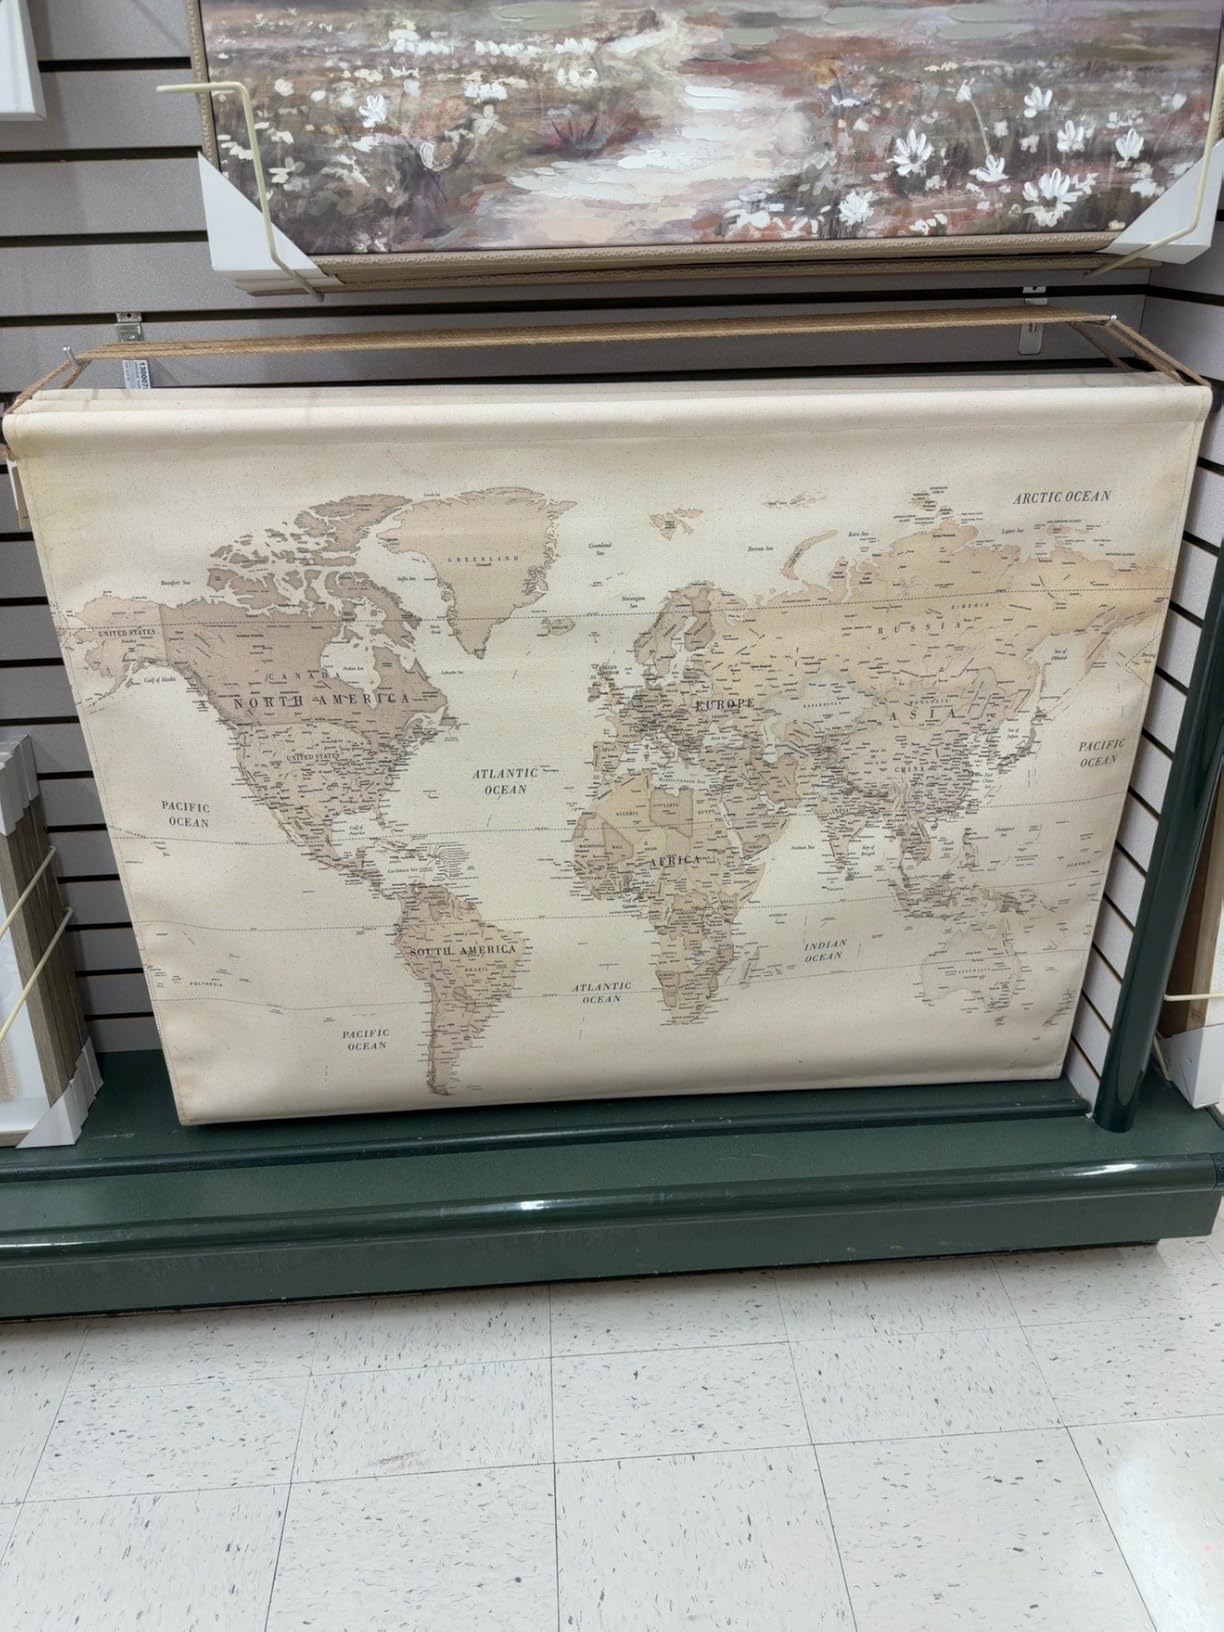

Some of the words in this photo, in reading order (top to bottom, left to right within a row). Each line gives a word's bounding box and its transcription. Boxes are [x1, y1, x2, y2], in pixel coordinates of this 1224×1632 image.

[1013, 491, 1062, 505] ARCTIC
[1065, 490, 1112, 502] OCEAN
[878, 621, 961, 634] RUSSIA
[268, 672, 340, 680] CANADA
[234, 696, 303, 709] NORTH
[319, 694, 409, 705] AMERICA
[696, 698, 754, 711] EUROPE
[890, 709, 955, 721] ASIA
[1079, 738, 1126, 752] PACIFIC
[1080, 756, 1117, 768] OCEAN
[473, 768, 538, 779] ATLANTIC
[485, 785, 527, 795] OCEAN
[162, 800, 210, 813] PACIFIC
[169, 816, 209, 828] OCEAN
[651, 856, 700, 867] AFRICA
[410, 947, 451, 956] SOUTH
[460, 945, 516, 956] AMERICA
[804, 939, 848, 951] INDIAN
[805, 952, 843, 963] OCEAN
[572, 982, 632, 992] ATLANTIC
[583, 995, 621, 1004] OCEAN
[343, 1029, 390, 1038] PACIFIC
[348, 1042, 387, 1051] OCEAN
